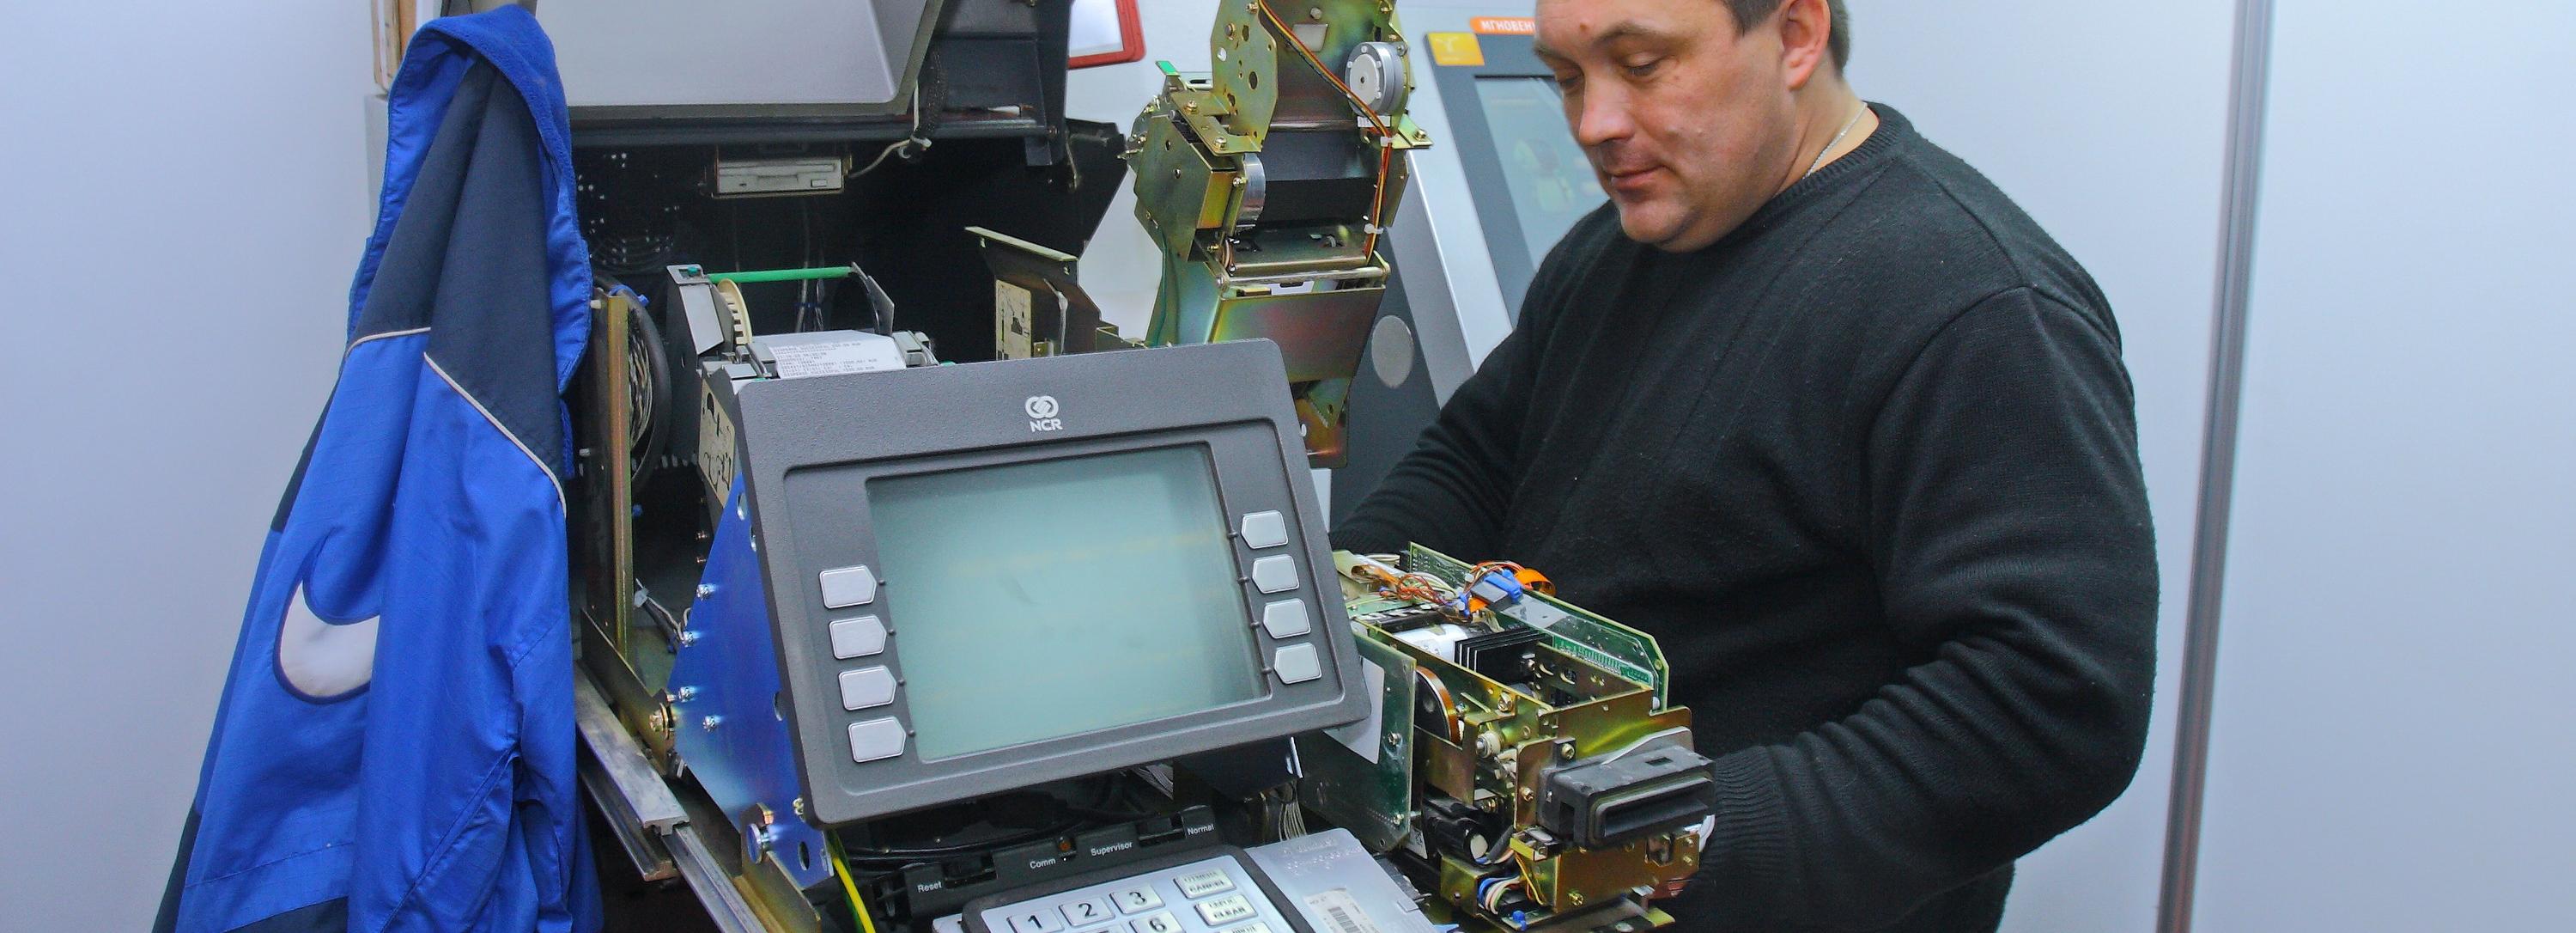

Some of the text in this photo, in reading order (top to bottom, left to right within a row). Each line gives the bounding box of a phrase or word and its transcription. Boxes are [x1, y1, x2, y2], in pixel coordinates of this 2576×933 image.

[1030, 418, 1063, 432] NCR
[1188, 823, 1215, 836] Normal
[1091, 842, 1133, 857] Supervisor
[1030, 858, 1056, 869] Comm
[917, 881, 942, 893] Reset
[1129, 891, 1147, 906] 3
[1078, 902, 1097, 918] 2
[1028, 915, 1042, 929] 1
[1149, 917, 1167, 933] 6
